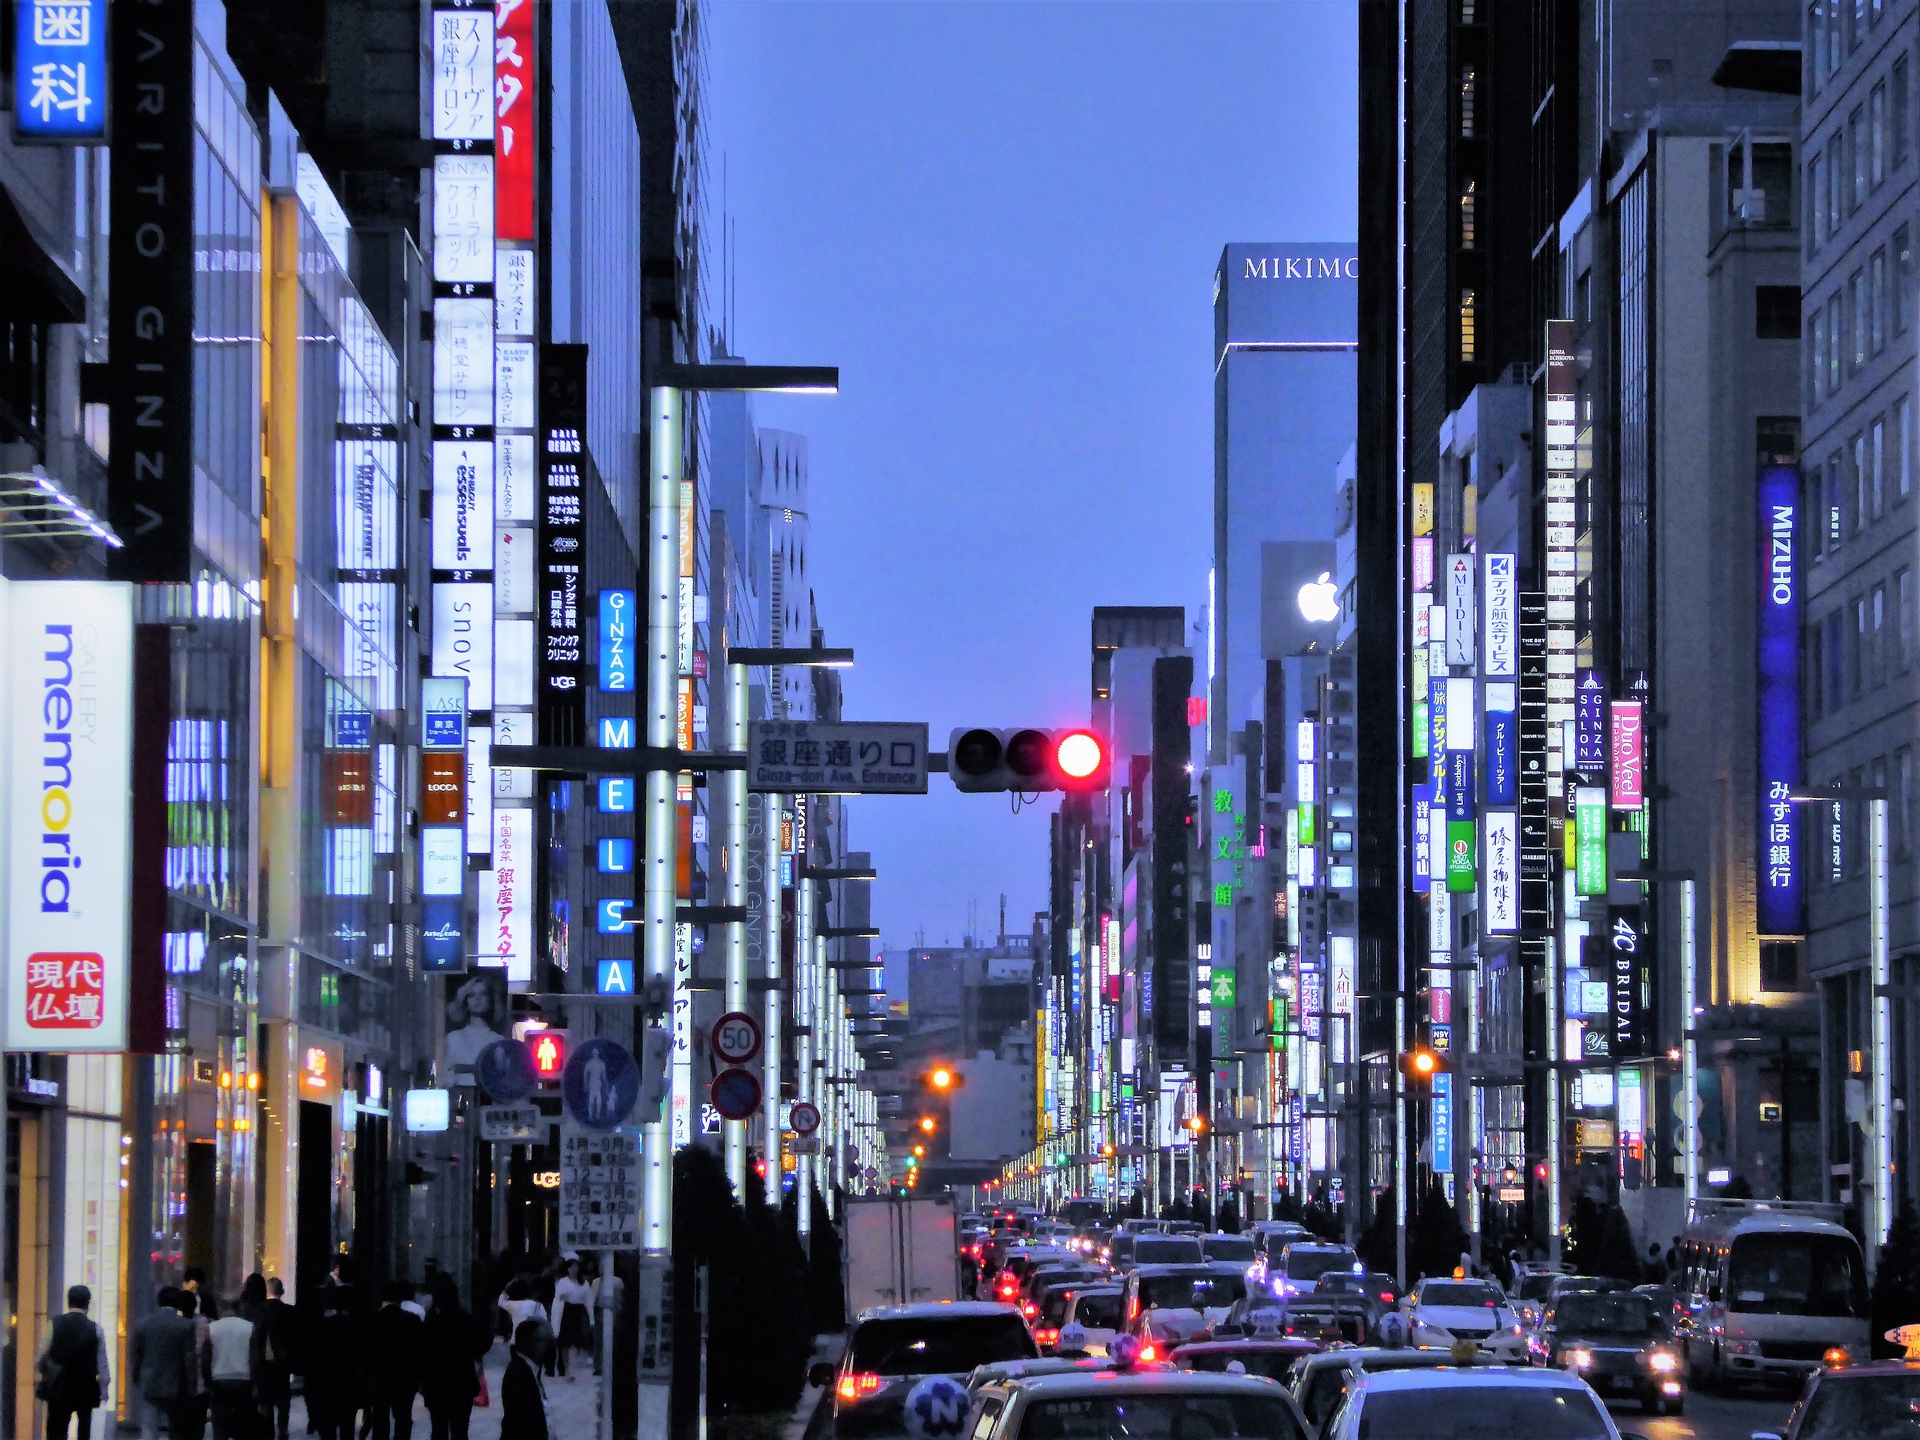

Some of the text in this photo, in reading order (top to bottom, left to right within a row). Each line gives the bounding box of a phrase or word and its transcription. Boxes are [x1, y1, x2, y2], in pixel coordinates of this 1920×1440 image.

[442, 17, 460, 132] 銀座サロン
[438, 161, 489, 175] GINZA
[446, 183, 460, 274] クリニック
[465, 183, 481, 257] オーラル
[453, 284, 475, 295] 4F
[136, 305, 164, 535] GINZA
[452, 427, 475, 438] 3F
[457, 465, 471, 561] essensuals
[453, 571, 473, 580] 2F
[502, 551, 511, 607] PASONA
[1770, 505, 1793, 605] MIZUHO
[547, 649, 580, 660] クリニック
[609, 592, 626, 669] GINZA
[1491, 577, 1509, 672] テック航空サービス
[78, 623, 98, 745] GALLERY
[760, 739, 915, 767] 銀座通り口
[1580, 695, 1589, 757] SALON
[1594, 695, 1602, 757] GINZA
[1621, 715, 1640, 755] Duo
[41, 624, 82, 912] memoria
[757, 768, 824, 784] Ginza-dori
[862, 769, 917, 785] Entrance
[499, 814, 512, 862] 中国名菜
[1214, 789, 1232, 907] 教文館
[1416, 801, 1429, 876] 洋服の青山
[1769, 780, 1791, 888] みずほ銀行
[28, 960, 102, 990] 現代
[1143, 971, 1152, 1012] TASAKI
[1616, 960, 1631, 1043] BRIDAL
[27, 992, 101, 1021] 仏壇
[722, 1026, 750, 1050] 50
[1293, 1101, 1301, 1158] CHAUMET
